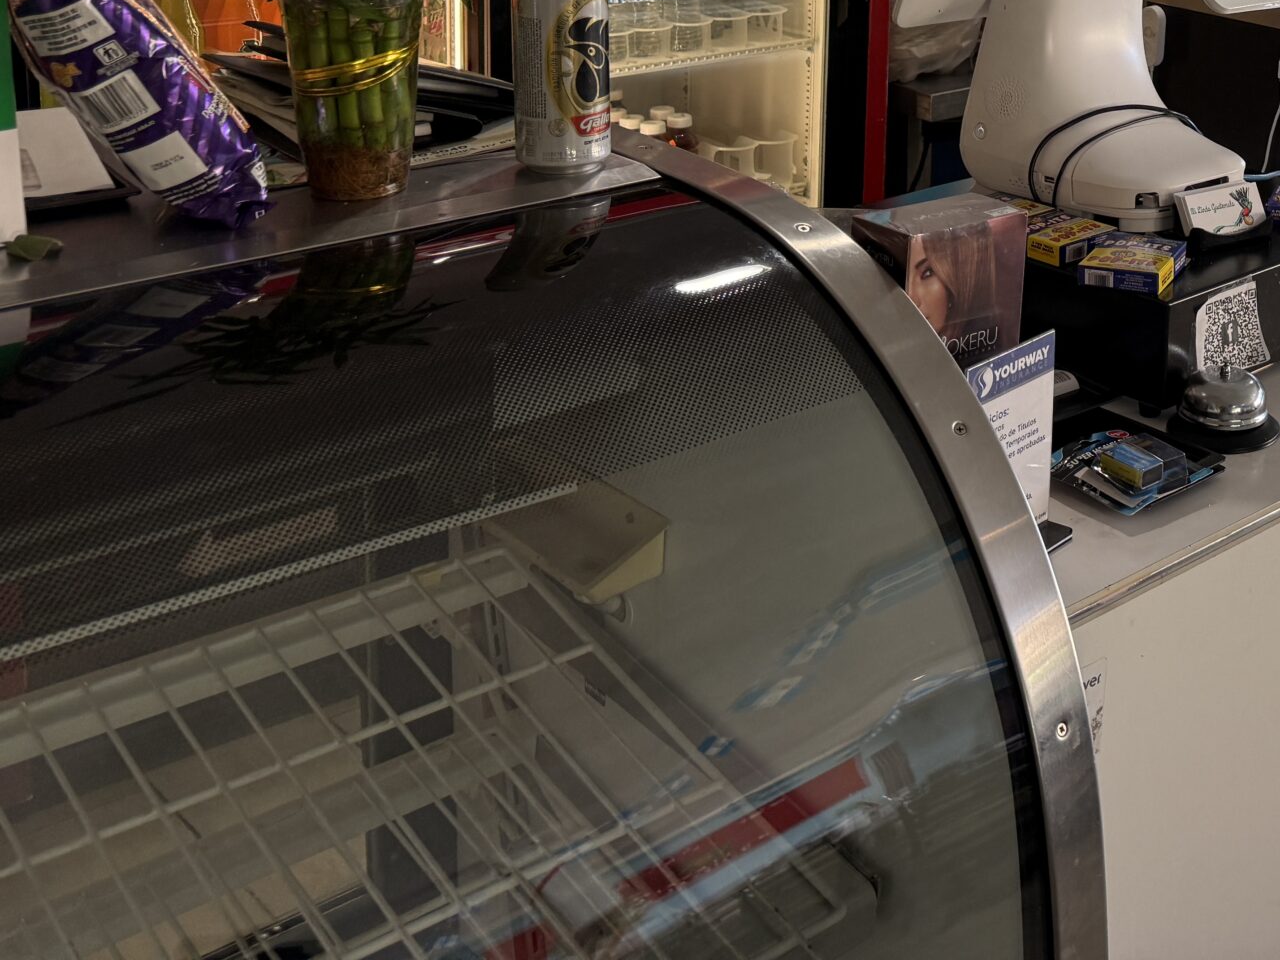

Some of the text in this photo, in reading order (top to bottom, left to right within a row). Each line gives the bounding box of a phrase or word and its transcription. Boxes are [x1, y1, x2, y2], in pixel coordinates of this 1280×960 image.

[994, 345, 1050, 382] YOURWAY
[989, 407, 1010, 423] icios:
[1005, 427, 1039, 450] Temporales
[1008, 428, 1017, 438] de
[1016, 434, 1046, 456] aprobadas
[1066, 451, 1094, 470] SUPER
[1082, 673, 1102, 691] ver
